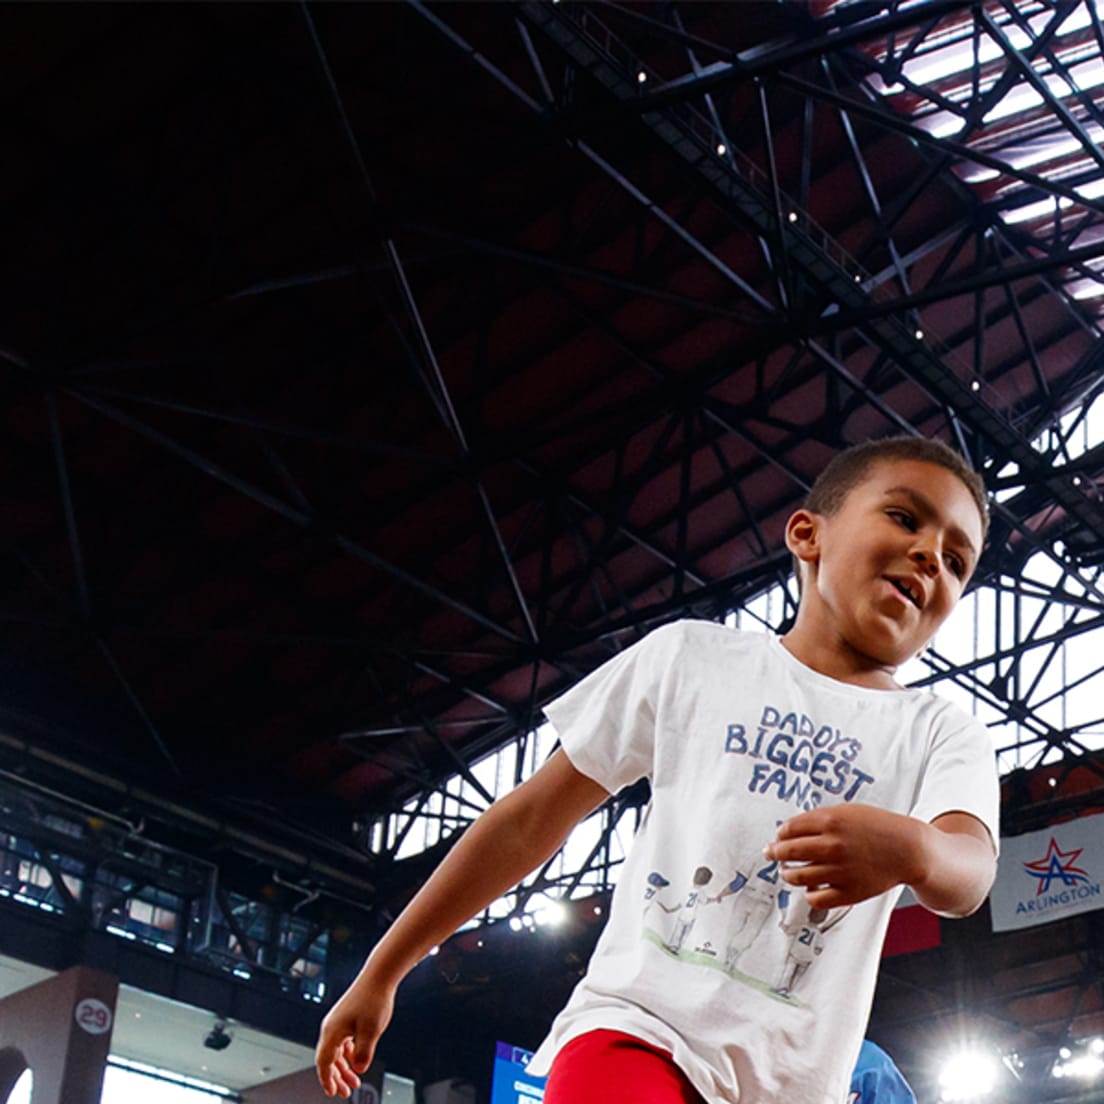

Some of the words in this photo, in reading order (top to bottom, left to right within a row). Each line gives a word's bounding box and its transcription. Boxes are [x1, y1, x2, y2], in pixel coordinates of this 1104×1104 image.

[725, 723, 875, 802] BIGGEST
[748, 763, 822, 811] FANS
[1016, 883, 1101, 914] ARLINGTON
[798, 927, 816, 946] 21
